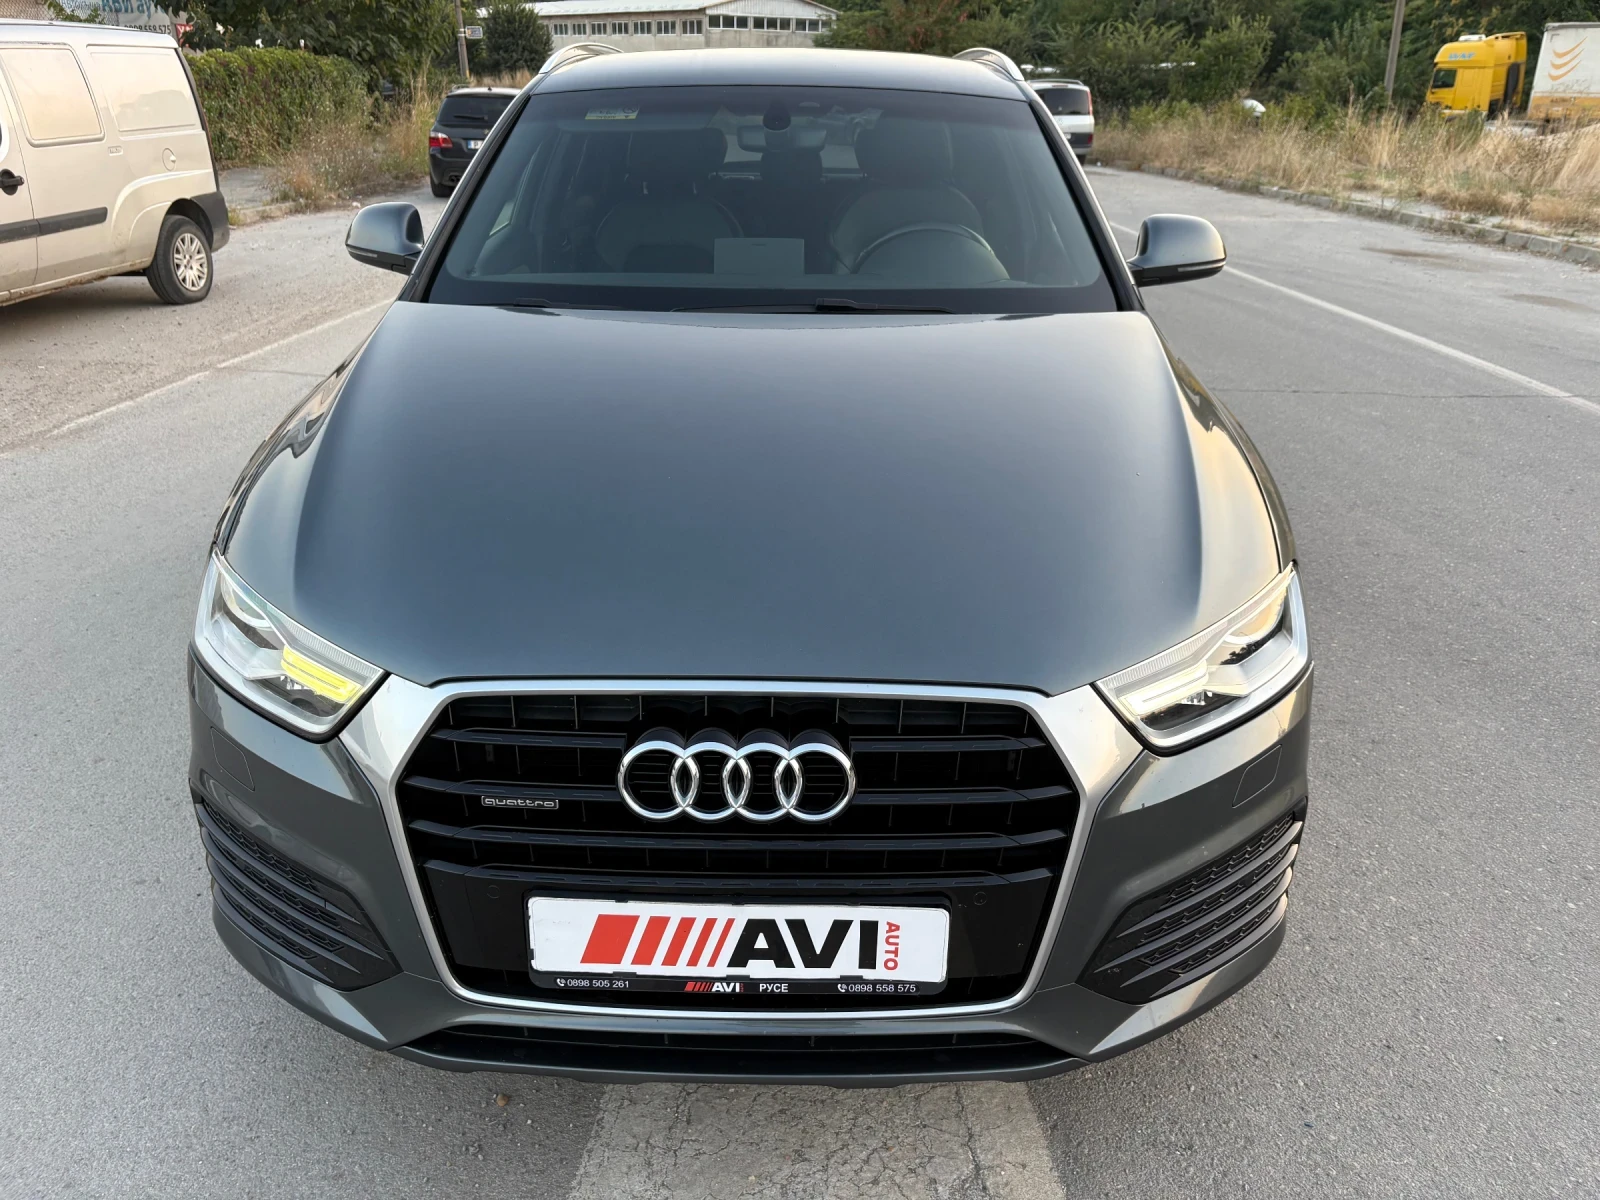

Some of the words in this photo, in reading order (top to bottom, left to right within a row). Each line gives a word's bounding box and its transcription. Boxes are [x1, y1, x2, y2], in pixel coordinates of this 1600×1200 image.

[484, 798, 555, 807] quattro
[727, 918, 879, 969] AVI
[883, 921, 901, 971] AUTO
[567, 978, 590, 987] 0898
[592, 979, 610, 988] 505
[612, 980, 629, 988] 261
[711, 982, 740, 992] AVI
[759, 983, 789, 993] РУСЕ
[848, 983, 873, 993] 0898
[875, 983, 895, 993] 558
[897, 983, 916, 993] 575
